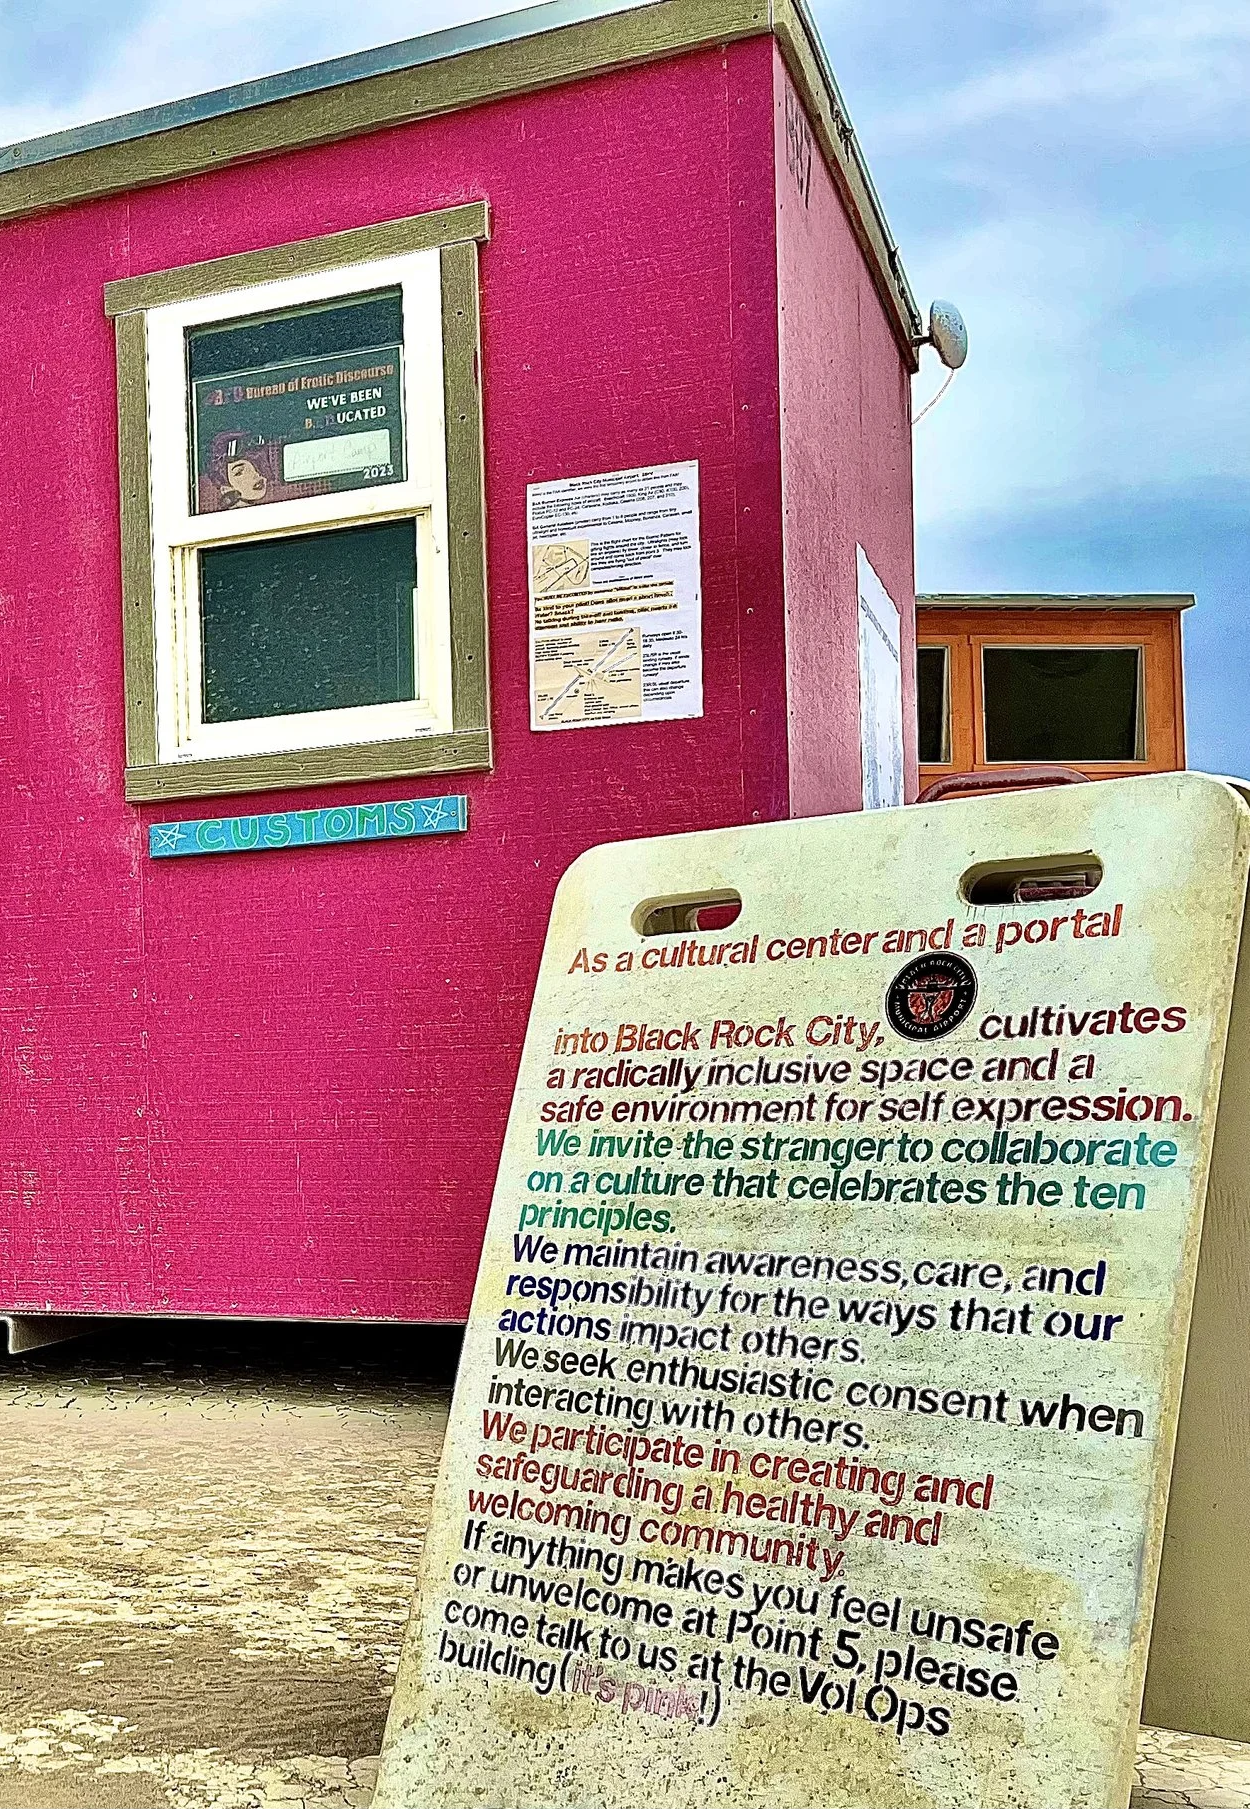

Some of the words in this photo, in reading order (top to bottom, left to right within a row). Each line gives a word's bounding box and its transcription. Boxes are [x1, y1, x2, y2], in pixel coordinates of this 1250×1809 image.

[288, 378, 299, 392] of
[300, 372, 334, 390] Erotic
[336, 363, 394, 384] Discourse
[307, 393, 346, 410] WE'VE
[350, 387, 382, 401] BEEN
[363, 464, 394, 479] 2023
[197, 802, 415, 850] CUSTOMS
[568, 948, 608, 974] As
[614, 952, 633, 972] a
[641, 934, 759, 969] cultural
[766, 931, 871, 961] center
[882, 918, 954, 953] and
[962, 924, 986, 947] a
[993, 904, 1123, 954] portal
[554, 1027, 608, 1055] into
[612, 1022, 702, 1054] Black
[710, 1017, 796, 1049] Rock
[806, 1014, 884, 1052] City,
[975, 1002, 1187, 1042] cultivates
[547, 1068, 565, 1089] a
[570, 1058, 703, 1094] radically
[703, 1054, 851, 1087] inclusive
[860, 1057, 974, 1091] space
[982, 1048, 1059, 1082] and
[1069, 1054, 1095, 1080] a
[540, 1095, 604, 1123] safe
[612, 1092, 818, 1123] environment
[824, 1091, 876, 1123] for
[878, 1090, 948, 1122] self
[952, 1087, 1192, 1130] expression.
[535, 1129, 581, 1156] We
[588, 1128, 673, 1158] invite
[681, 1129, 733, 1160] the
[740, 1131, 895, 1168] stranger
[897, 1129, 933, 1163] to
[941, 1131, 1177, 1167] collaborate
[519, 1199, 676, 1236] principles.
[527, 1171, 563, 1193] on
[571, 1172, 590, 1194] a
[596, 1166, 704, 1196] culture
[712, 1167, 780, 1198] that
[786, 1169, 989, 1205] celebrates
[995, 1172, 1063, 1207] the
[1074, 1176, 1145, 1209] ten
[514, 1234, 559, 1264] We
[563, 1239, 699, 1273] maintain
[705, 1246, 909, 1290] awareness,
[913, 1261, 1012, 1294] care,
[1022, 1260, 1106, 1297] and
[497, 1306, 611, 1341] actions
[620, 1313, 734, 1354] impact
[741, 1325, 865, 1365] others.
[506, 1275, 713, 1318] responsibility
[719, 1283, 768, 1315] for
[773, 1287, 829, 1319] the
[838, 1298, 937, 1338] ways
[947, 1297, 1035, 1336] that
[1050, 1307, 1124, 1343] our
[488, 1376, 653, 1422] interacting
[662, 1397, 734, 1432] with
[743, 1407, 869, 1449] others.
[496, 1337, 539, 1369] We
[543, 1348, 619, 1380] seek
[627, 1356, 834, 1403] enthusiastic
[846, 1382, 1010, 1423] consent
[1019, 1395, 1144, 1439] when
[483, 1409, 527, 1445] We
[530, 1424, 704, 1468] participate
[710, 1439, 743, 1474] in
[750, 1453, 906, 1508] creating
[914, 1474, 994, 1510] and
[476, 1452, 683, 1517] safeguarding
[692, 1485, 712, 1510] a
[720, 1481, 860, 1541] healthy
[861, 1510, 942, 1546] and
[469, 1489, 631, 1545] welcoming
[640, 1519, 845, 1583] community.
[464, 1519, 487, 1551] If
[491, 1531, 624, 1586] anything
[632, 1554, 744, 1599] makes
[752, 1577, 819, 1616] you
[828, 1585, 902, 1632] feel
[911, 1604, 1059, 1664] unsafe
[454, 1563, 486, 1589] or
[491, 1568, 672, 1629] unwelcome
[682, 1606, 719, 1638] at
[728, 1608, 824, 1663] Point
[832, 1629, 866, 1675] 5,
[874, 1644, 1020, 1703] please
[445, 1600, 528, 1639] come
[536, 1614, 594, 1654] talk
[599, 1627, 630, 1661] to
[637, 1640, 677, 1671] us
[688, 1650, 724, 1686] at
[733, 1655, 792, 1698] the
[799, 1666, 856, 1715] Vol
[857, 1683, 951, 1737] Ops
